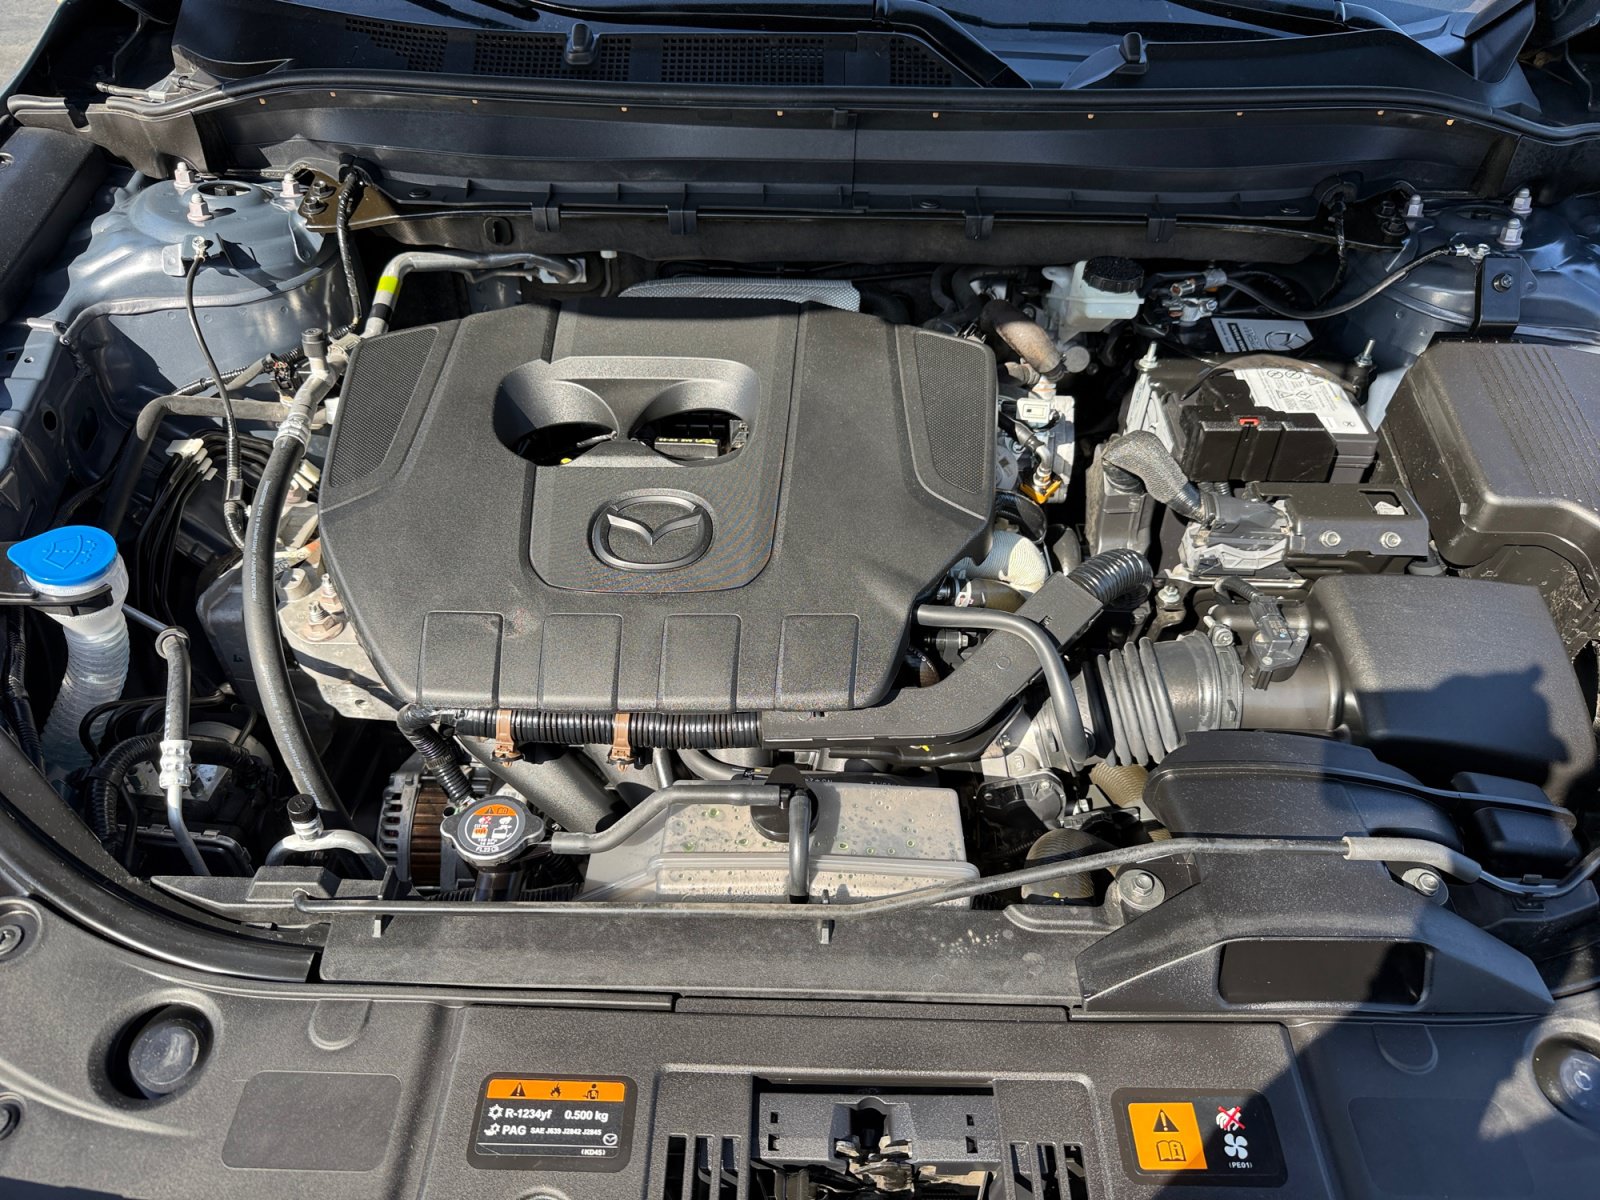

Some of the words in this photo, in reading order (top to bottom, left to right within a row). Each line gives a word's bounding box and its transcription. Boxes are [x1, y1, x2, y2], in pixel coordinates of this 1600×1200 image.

[504, 1108, 553, 1121] R-1234yf
[564, 1110, 593, 1120] 0.500
[594, 1110, 609, 1123] kg
[501, 1125, 527, 1136] PAG
[530, 1127, 545, 1135] SAE
